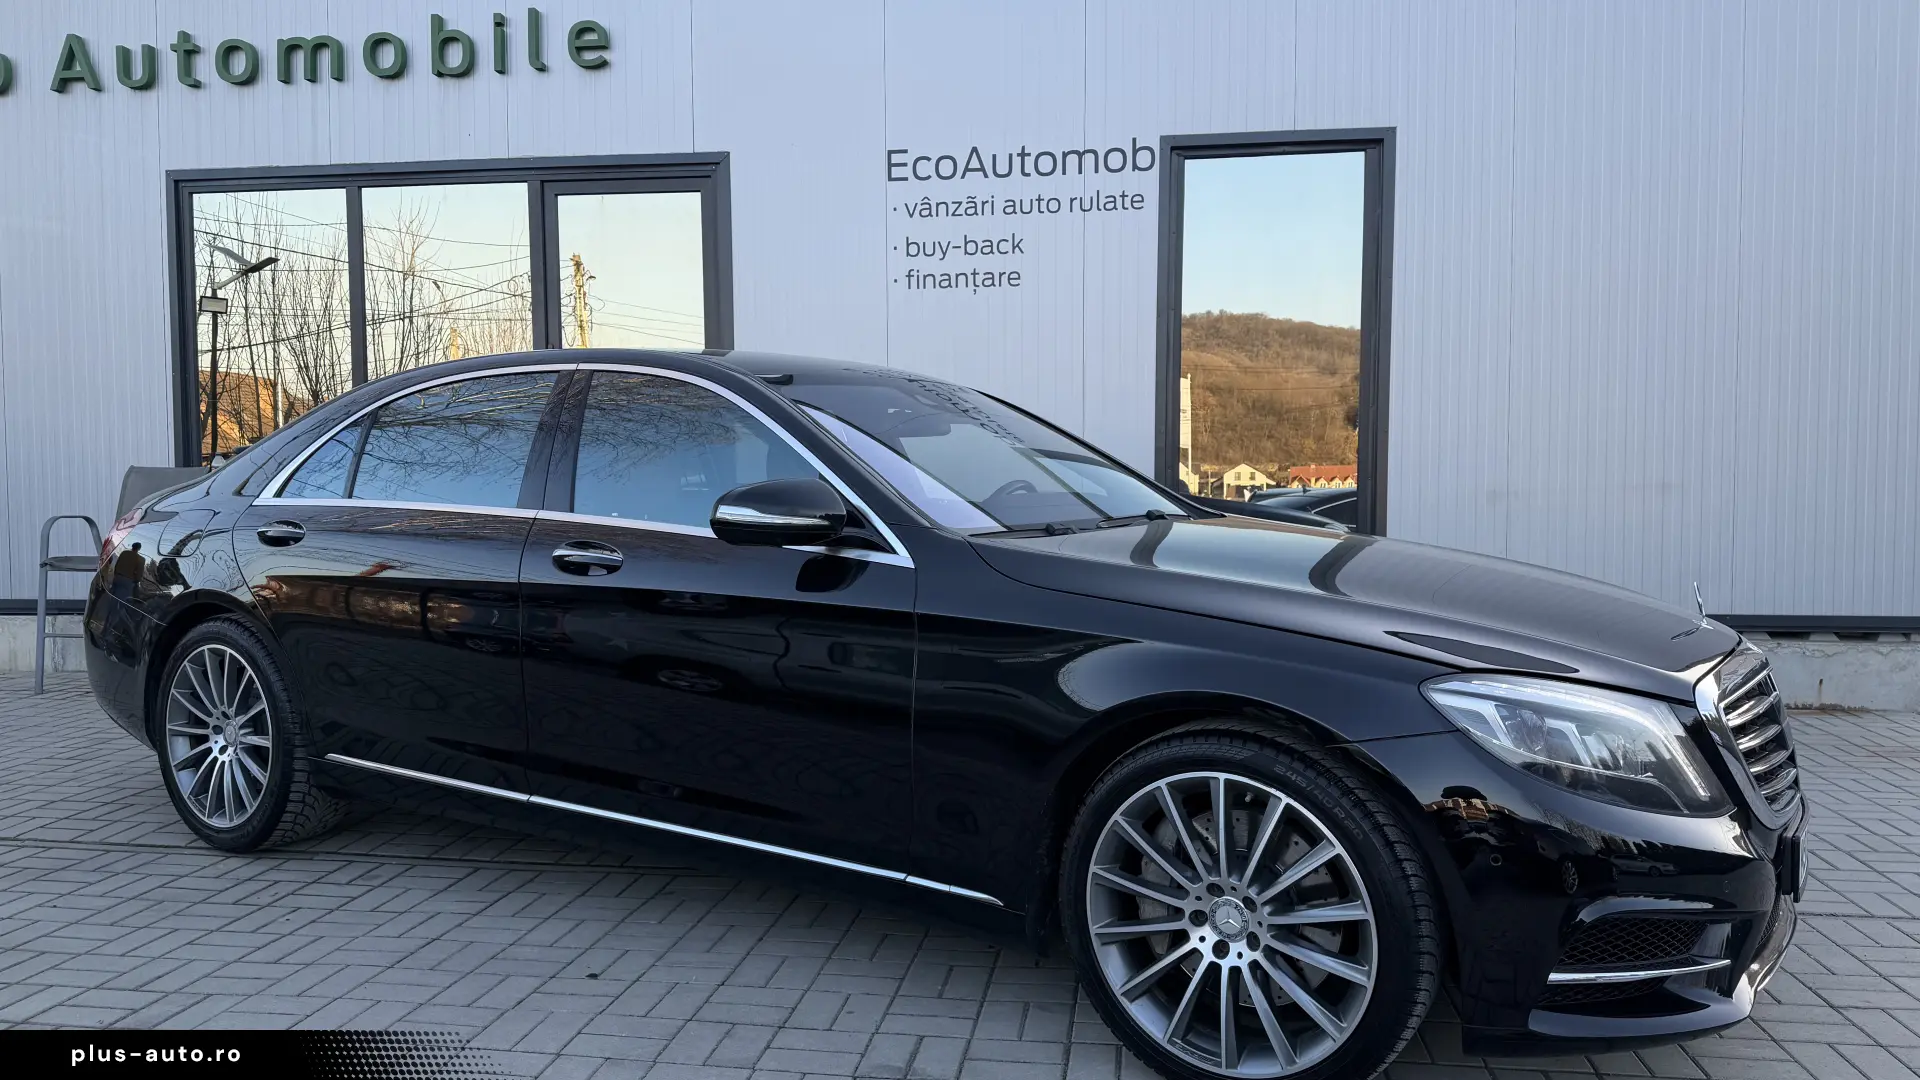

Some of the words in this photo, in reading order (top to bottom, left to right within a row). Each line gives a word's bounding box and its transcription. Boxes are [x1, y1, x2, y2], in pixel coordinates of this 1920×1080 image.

[50, 8, 611, 92] Automobile
[887, 137, 1156, 182] EcoAutomob
[1002, 193, 1062, 216] auto
[1069, 189, 1145, 213] rulate
[905, 232, 1025, 261] buy-back
